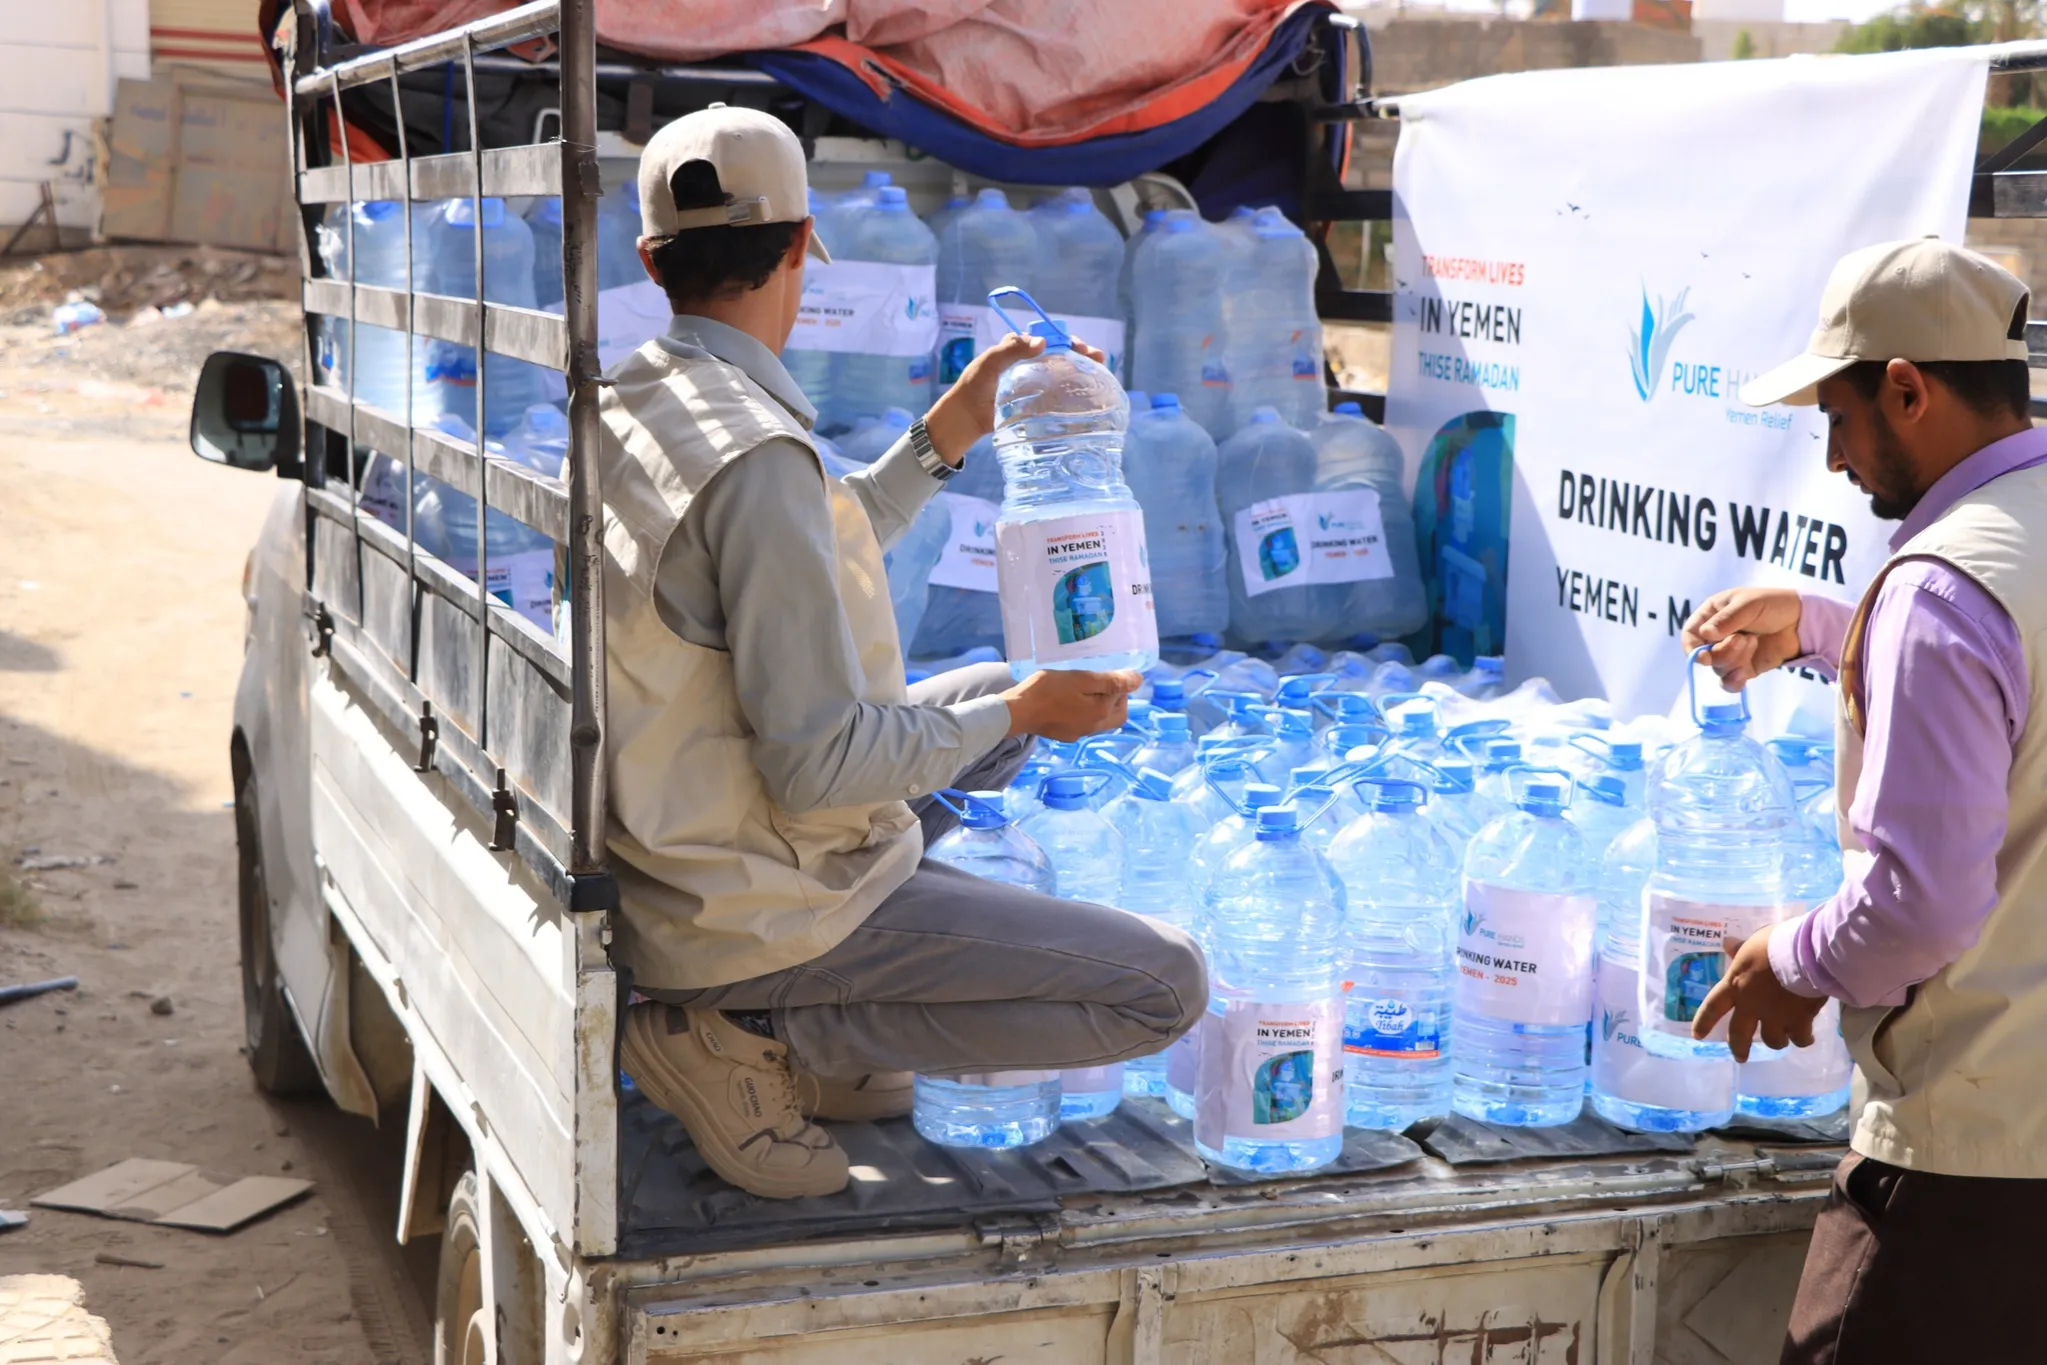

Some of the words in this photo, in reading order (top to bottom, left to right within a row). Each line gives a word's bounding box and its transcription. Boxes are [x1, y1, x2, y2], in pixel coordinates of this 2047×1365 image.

[1422, 255, 1486, 281] TRANSFORM
[1489, 261, 1524, 286] LIVES
[1420, 296, 1442, 334] IN
[1448, 299, 1521, 345] YEMEN
[1418, 351, 1452, 381] THISE
[1454, 357, 1519, 392] RAMADAN
[1672, 361, 1721, 398] PURE
[1725, 407, 1758, 426] Yemen
[1761, 411, 1793, 430] Relief
[1558, 469, 1717, 552] DRINKING
[1728, 502, 1848, 585] WATER
[1047, 546, 1059, 555] IN
[1061, 540, 1101, 553] YEMEN
[1556, 565, 1638, 627] YEMEN
[1480, 927, 1496, 940] PURE
[1670, 924, 1680, 934] IN
[1682, 927, 1721, 939] YEMEN
[1456, 946, 1491, 966] RINKING
[1493, 957, 1537, 974] WATER
[1494, 974, 1518, 986] 2025
[1257, 1028, 1269, 1037] IN
[1272, 1029, 1311, 1038] YEMEN
[1375, 1020, 1404, 1031] Tibah
